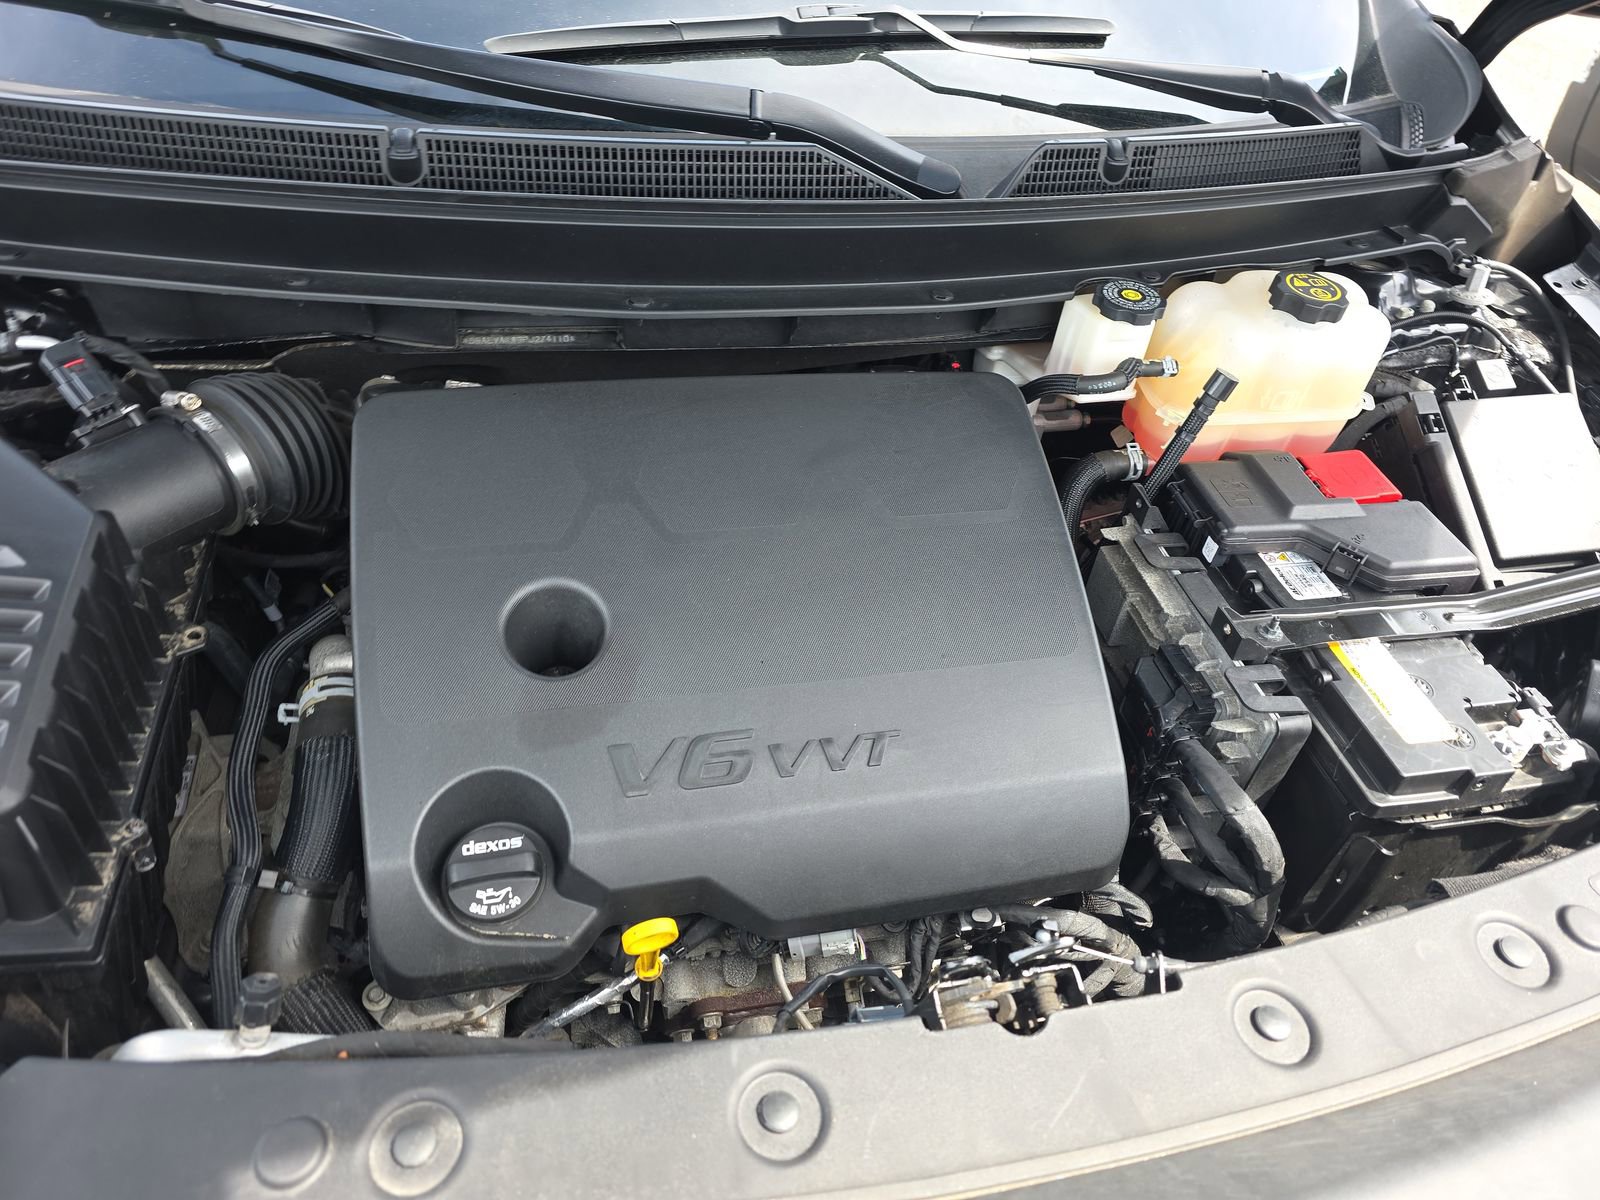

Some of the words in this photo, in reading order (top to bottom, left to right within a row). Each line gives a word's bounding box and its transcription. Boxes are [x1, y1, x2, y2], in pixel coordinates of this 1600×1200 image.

[607, 728, 755, 798] V6
[767, 729, 901, 778] VVT
[461, 835, 523, 856] dexos
[469, 902, 488, 916] SAE
